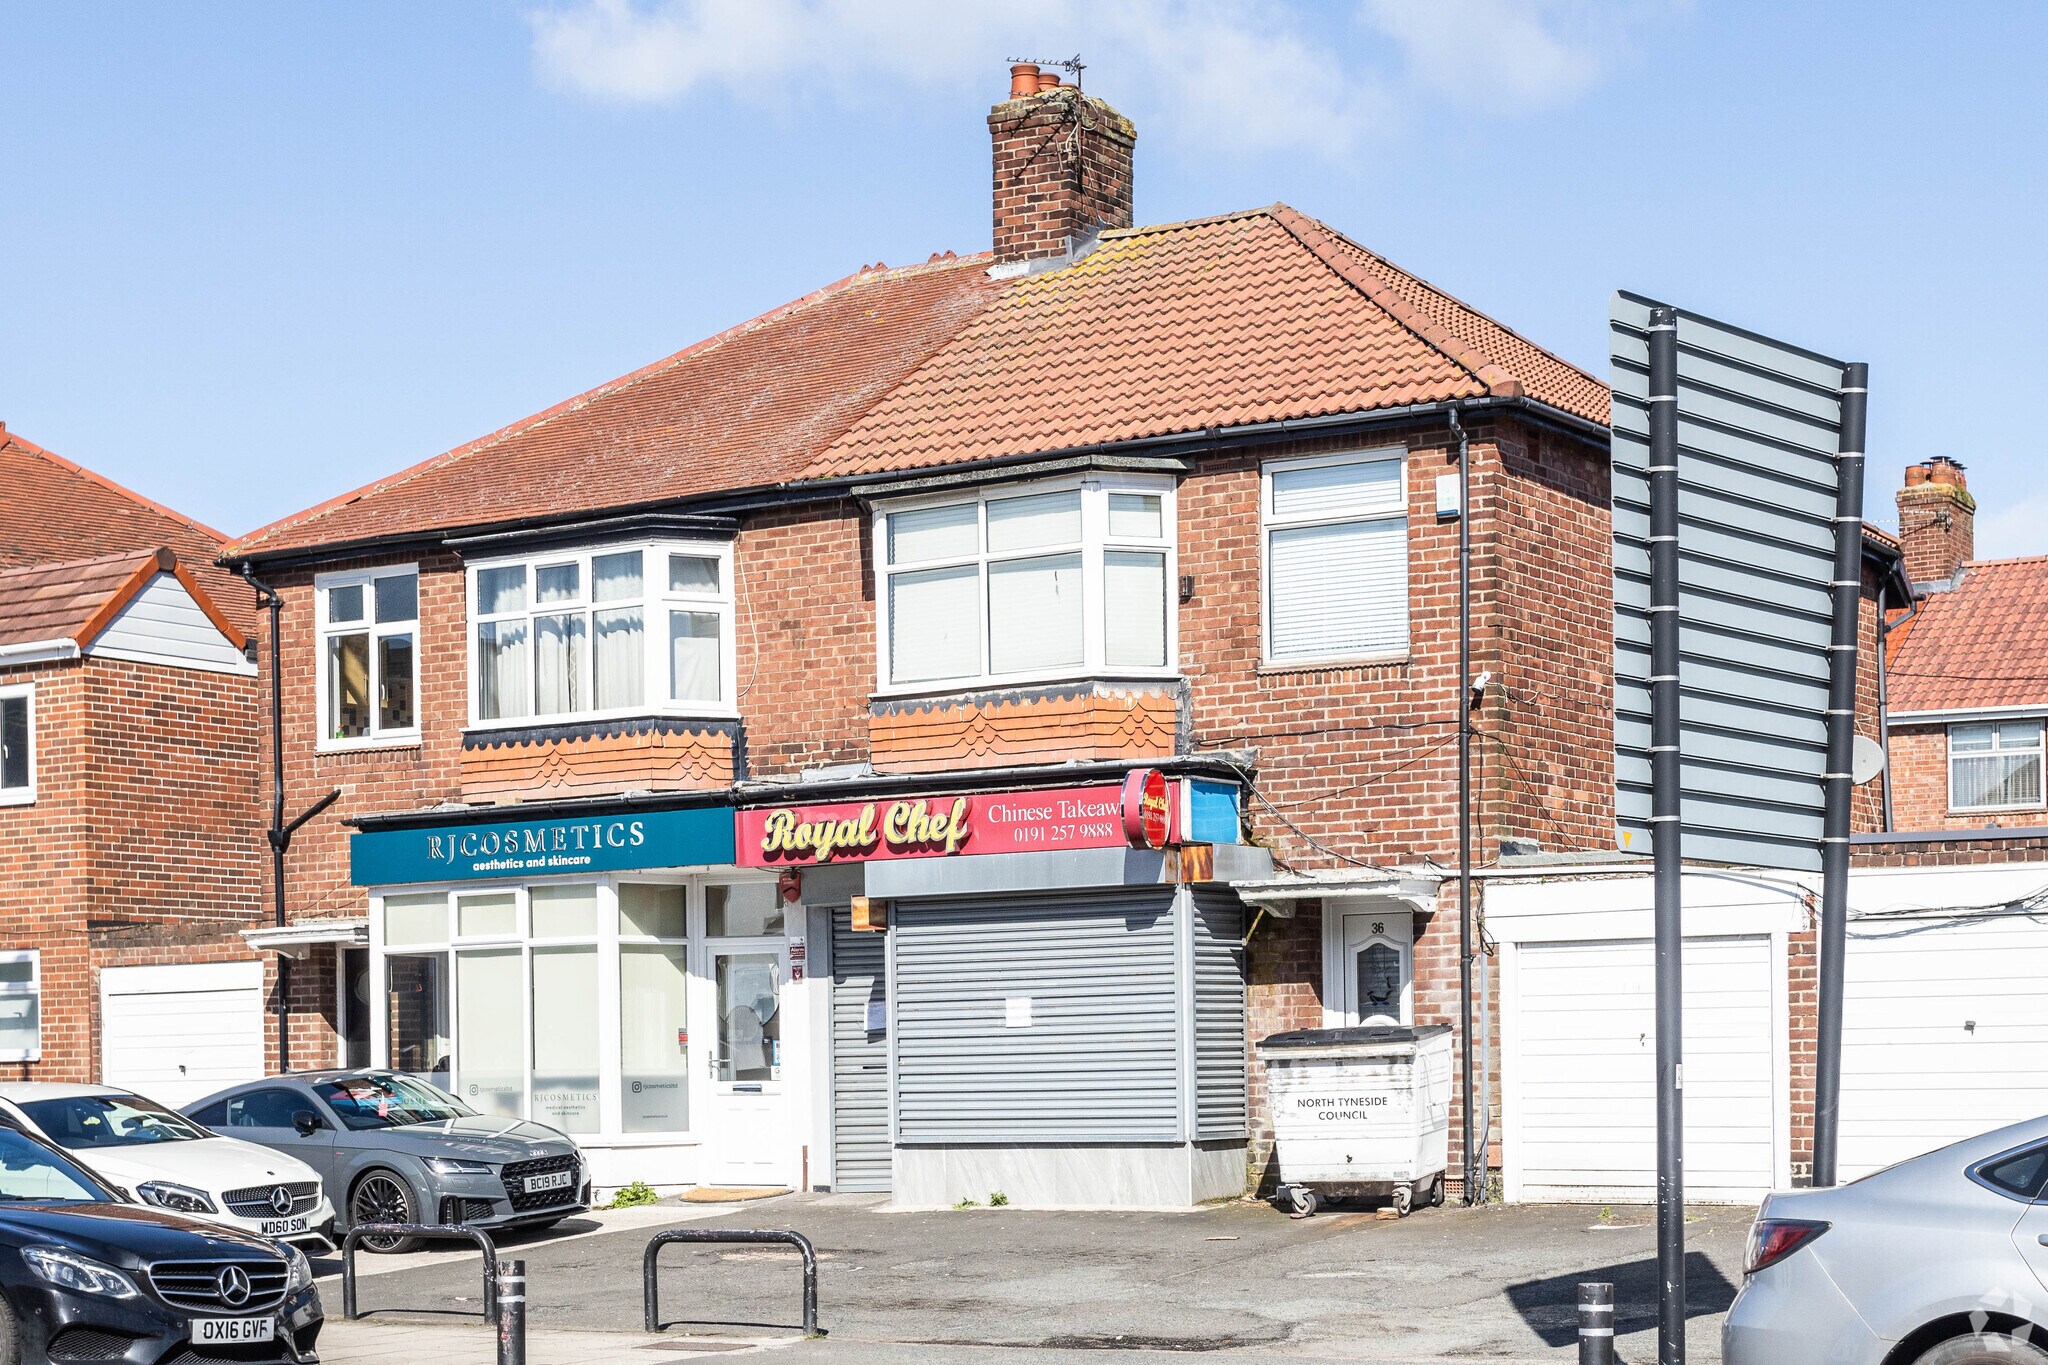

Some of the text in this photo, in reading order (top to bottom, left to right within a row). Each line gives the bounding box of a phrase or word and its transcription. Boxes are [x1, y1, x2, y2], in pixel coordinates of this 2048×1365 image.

[988, 799, 1121, 823] Chinese Takeaw
[760, 797, 970, 861] Royal Chef
[1014, 822, 1113, 842] 0191 257 9888
[427, 821, 645, 865] RJCOSMETICS
[473, 855, 591, 871] aesthetics and skincare
[1371, 922, 1385, 934] 36
[534, 1093, 597, 1102] RJCOSMETICS
[1297, 1096, 1388, 1108] NORTH TYNESIDE
[1318, 1110, 1368, 1121] COUNCIL
[530, 1174, 567, 1190] BC19 RJC
[261, 1217, 307, 1235] MD60 SON
[203, 1319, 268, 1339] OX16 GVF
